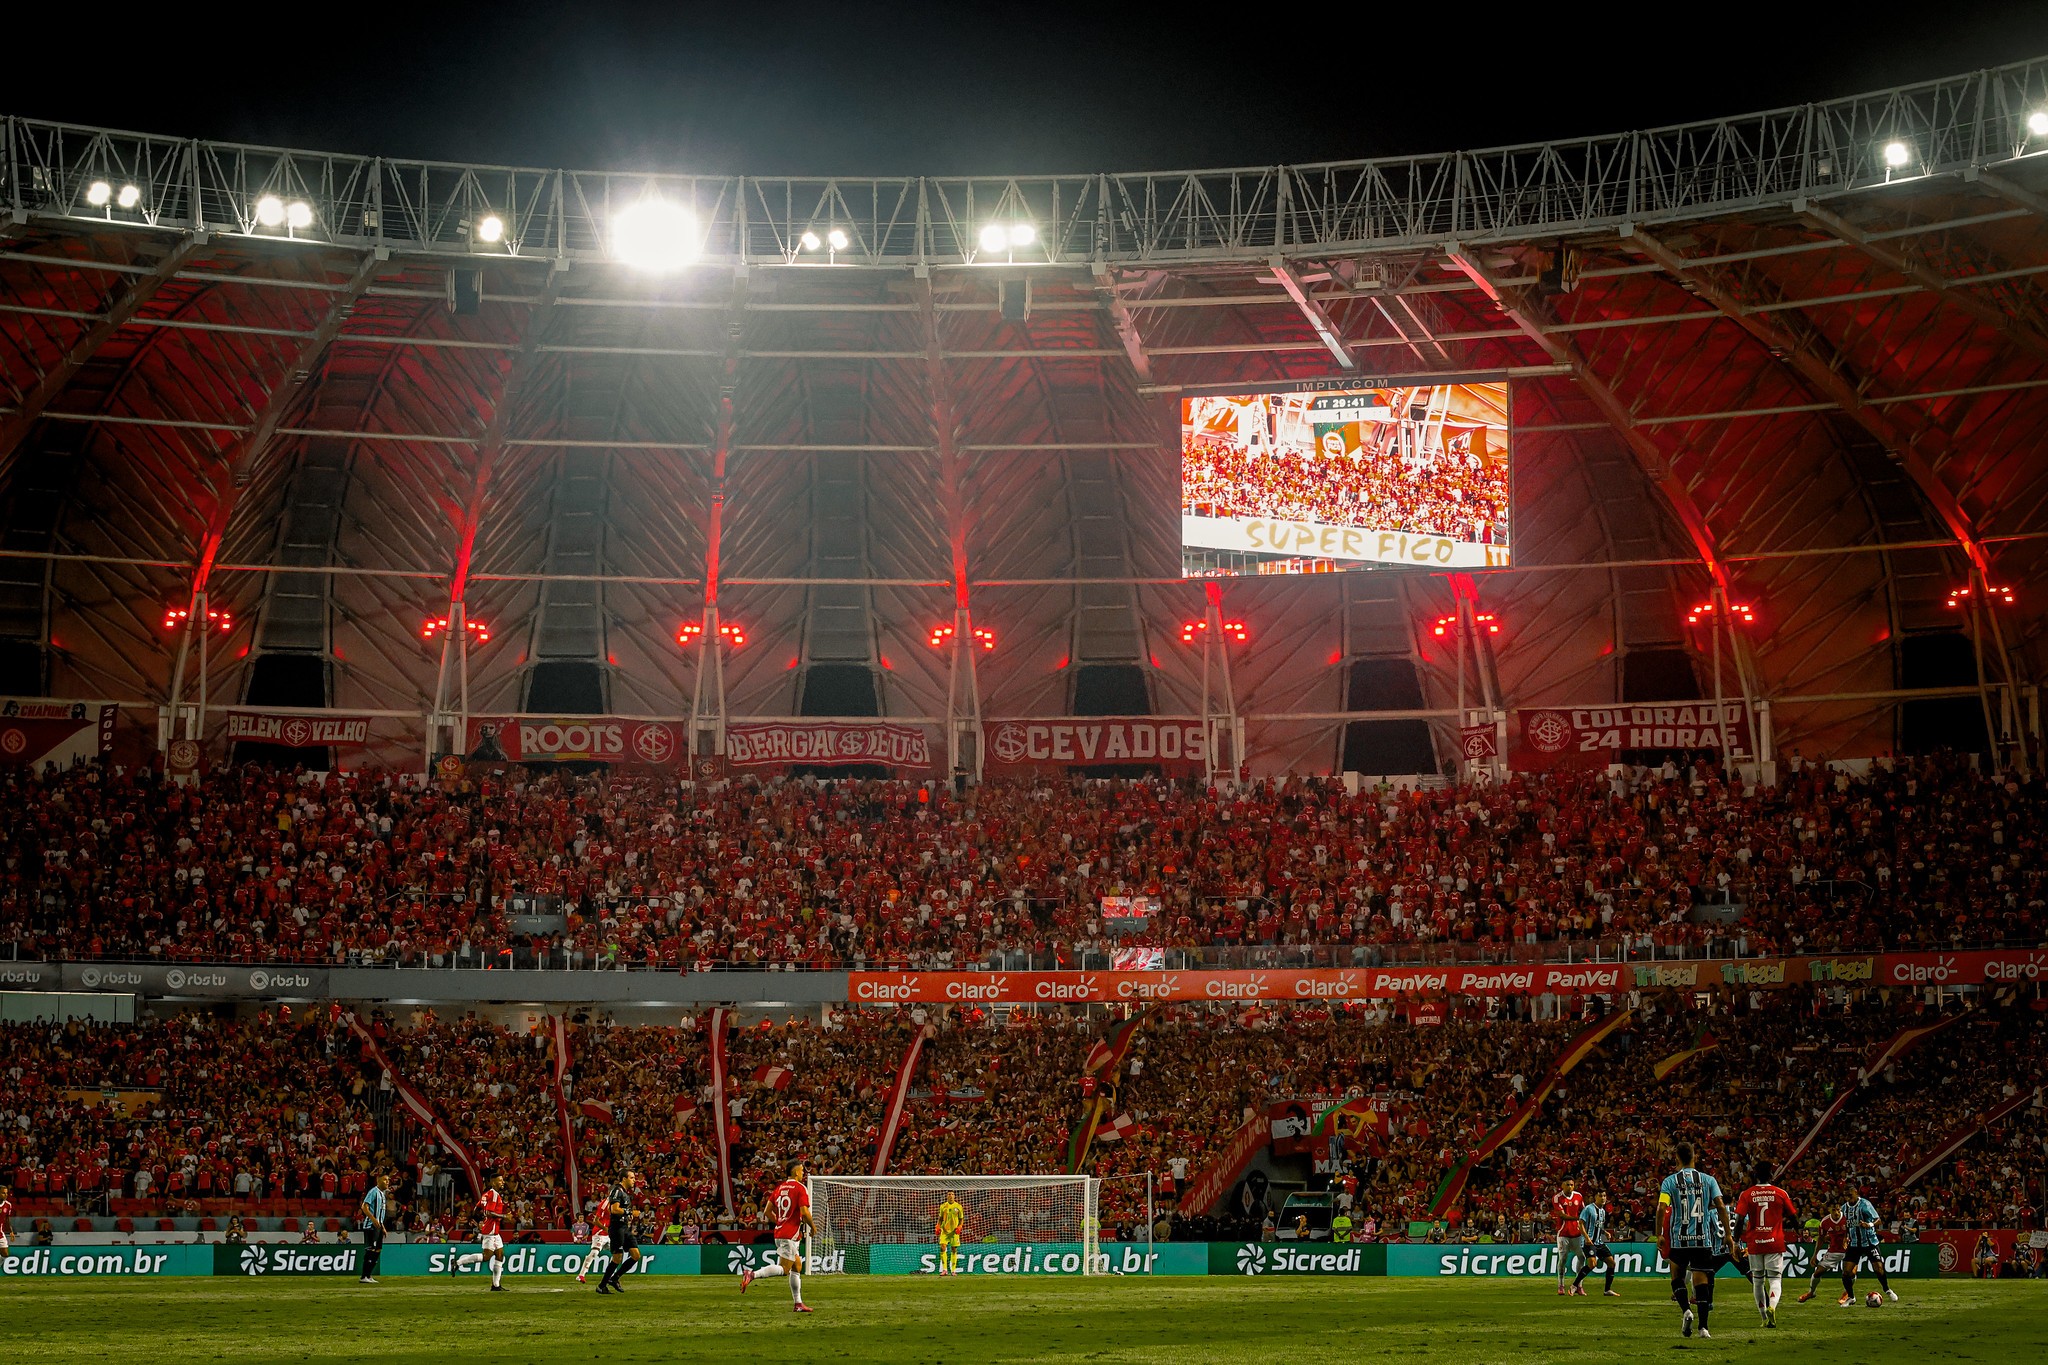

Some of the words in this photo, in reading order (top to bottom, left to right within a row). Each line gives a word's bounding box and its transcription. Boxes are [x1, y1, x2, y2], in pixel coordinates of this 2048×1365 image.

[1296, 379, 1389, 393] IMPLY.COM
[1332, 398, 1365, 408] 29:41
[1246, 520, 1363, 556] SUPER
[1378, 534, 1454, 563] FICO
[1572, 705, 1742, 729] COLORADO
[228, 715, 283, 740] BELÉM
[312, 720, 368, 743] VELHO
[521, 725, 624, 752] ROOTS
[1579, 732, 1620, 751] 24
[1629, 727, 1737, 748] HORAS
[1027, 724, 1206, 760] CEVADOS
[1546, 970, 1619, 988] PanVel
[1893, 961, 1952, 981] Claro
[1983, 958, 2043, 979] Claro
[857, 979, 914, 998] Claro
[945, 979, 1002, 998] Claro
[1035, 979, 1091, 998] Claro
[1206, 978, 1263, 997] Claro
[1295, 977, 1352, 996] Claro
[1374, 974, 1448, 991] PanVel
[1460, 971, 1534, 989] PanVel
[775, 1195, 792, 1219] 19
[1681, 1196, 1704, 1225] 14
[1758, 1202, 1769, 1227] 7
[272, 1249, 356, 1272] Sicredi
[1271, 1248, 1362, 1272] Sicredi
